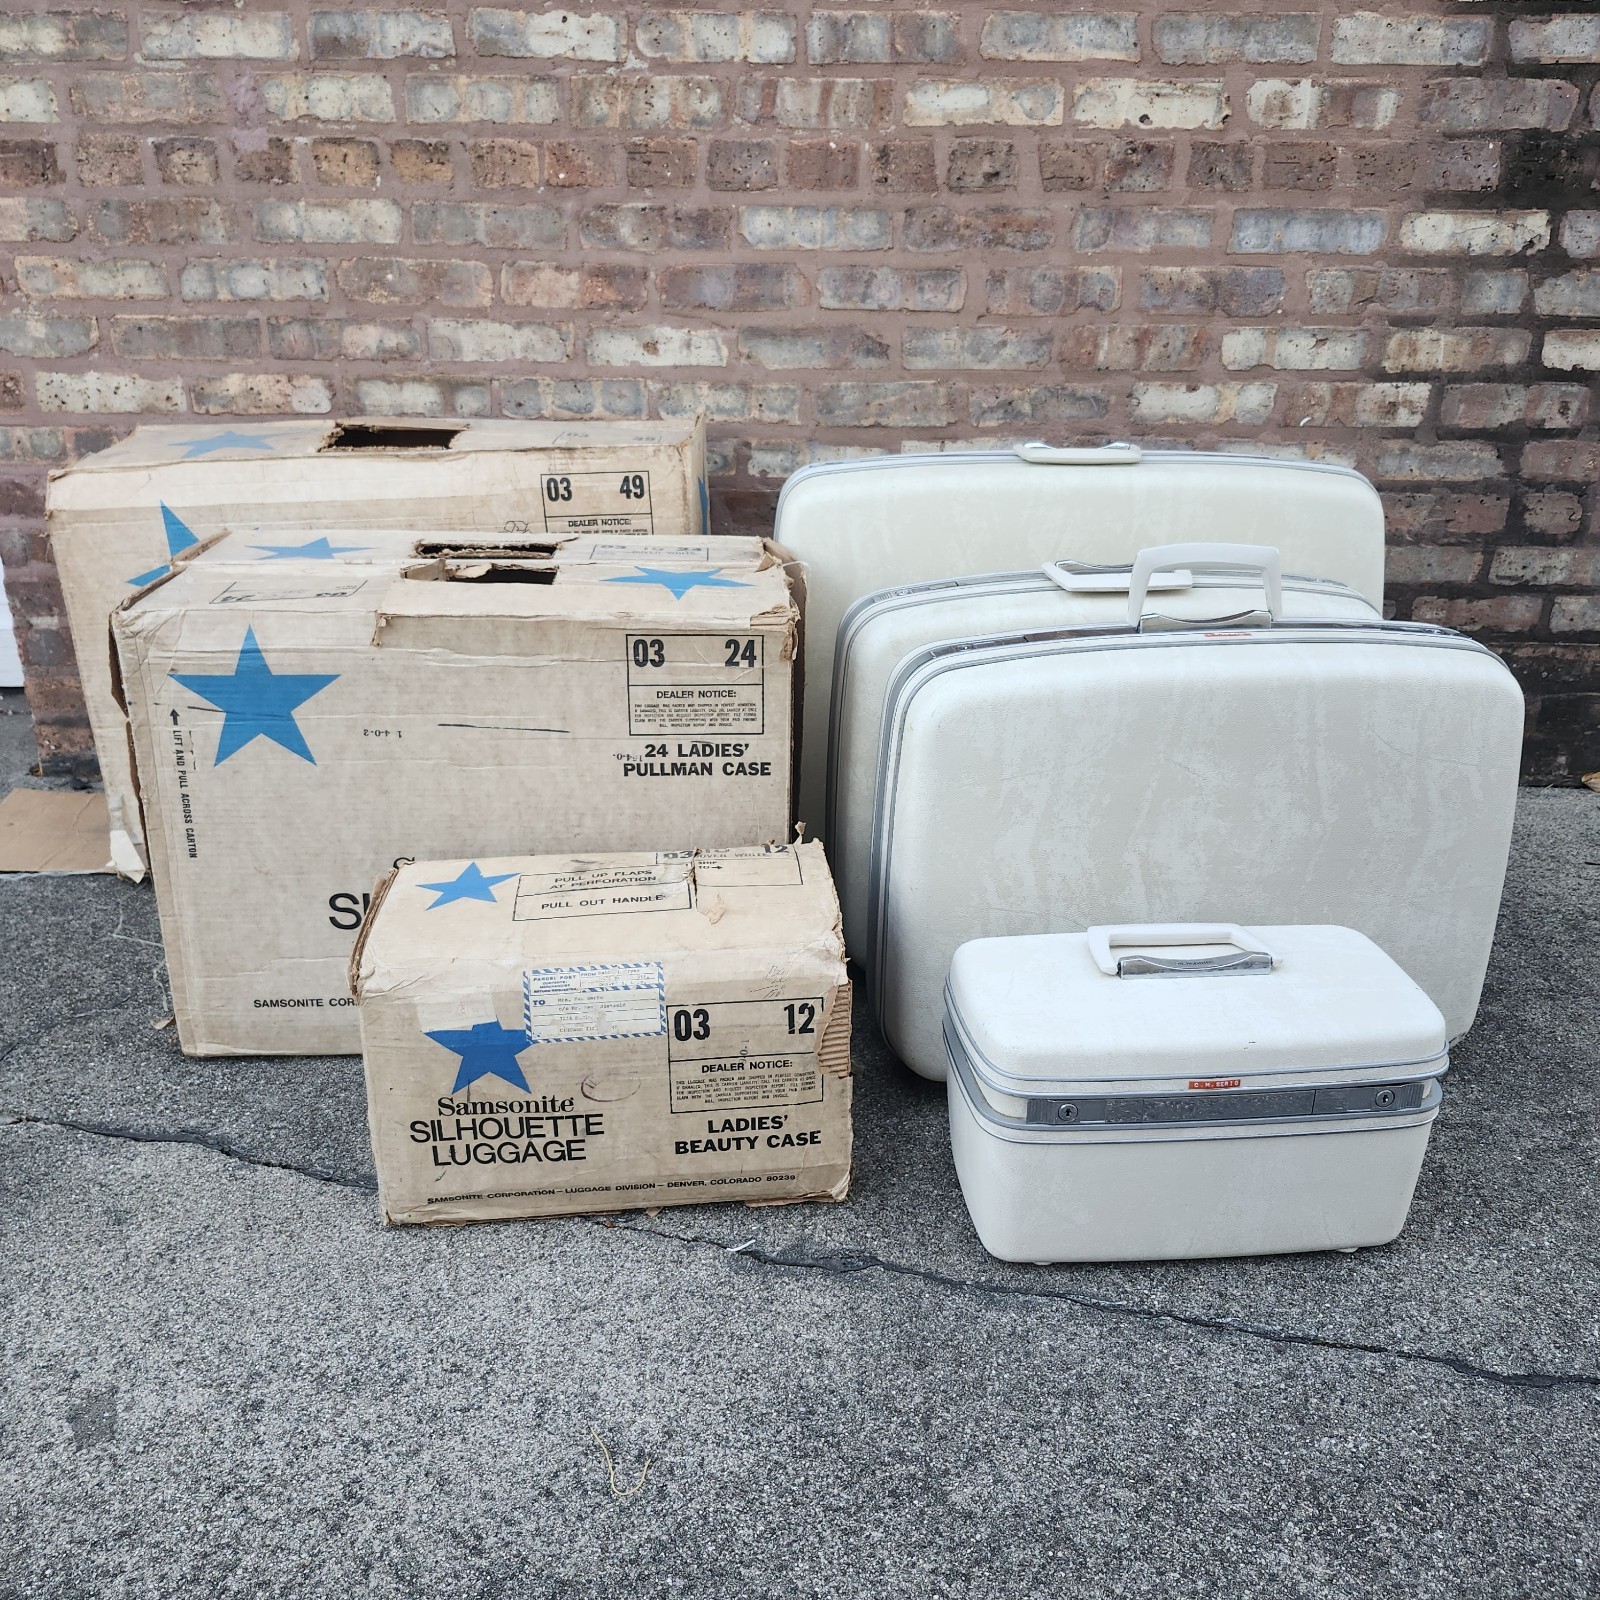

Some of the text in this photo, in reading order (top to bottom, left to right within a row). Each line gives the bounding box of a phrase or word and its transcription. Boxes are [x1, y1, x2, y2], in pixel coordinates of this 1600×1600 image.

[547, 475, 645, 502] 03 49
[568, 519, 598, 528] DEALER
[633, 638, 756, 668] 03 24
[656, 690, 737, 699] DEALER NOTICE:
[644, 744, 668, 758] 24
[677, 743, 749, 758] LADIES'
[623, 762, 771, 776] PULLMAN CASE
[173, 730, 197, 858] LIFT AND PULL ACROSS CARTON
[761, 843, 790, 854] 12
[571, 876, 656, 887] PERFORATION
[612, 895, 664, 903] HANDLE
[254, 998, 324, 1008] SAMSONITE
[674, 1003, 815, 1042] 03 12
[702, 1060, 793, 1073] DEALER NOTICE:
[438, 1095, 574, 1116] Samsonite
[410, 1113, 605, 1143] SILHOUETTE
[708, 1115, 788, 1134] LADIES'
[675, 1130, 822, 1155] BEAUTY CASE
[432, 1139, 586, 1166] LUGGAGE
[427, 1194, 484, 1204] SAMSONITE
[710, 1176, 762, 1186] COLORADO
